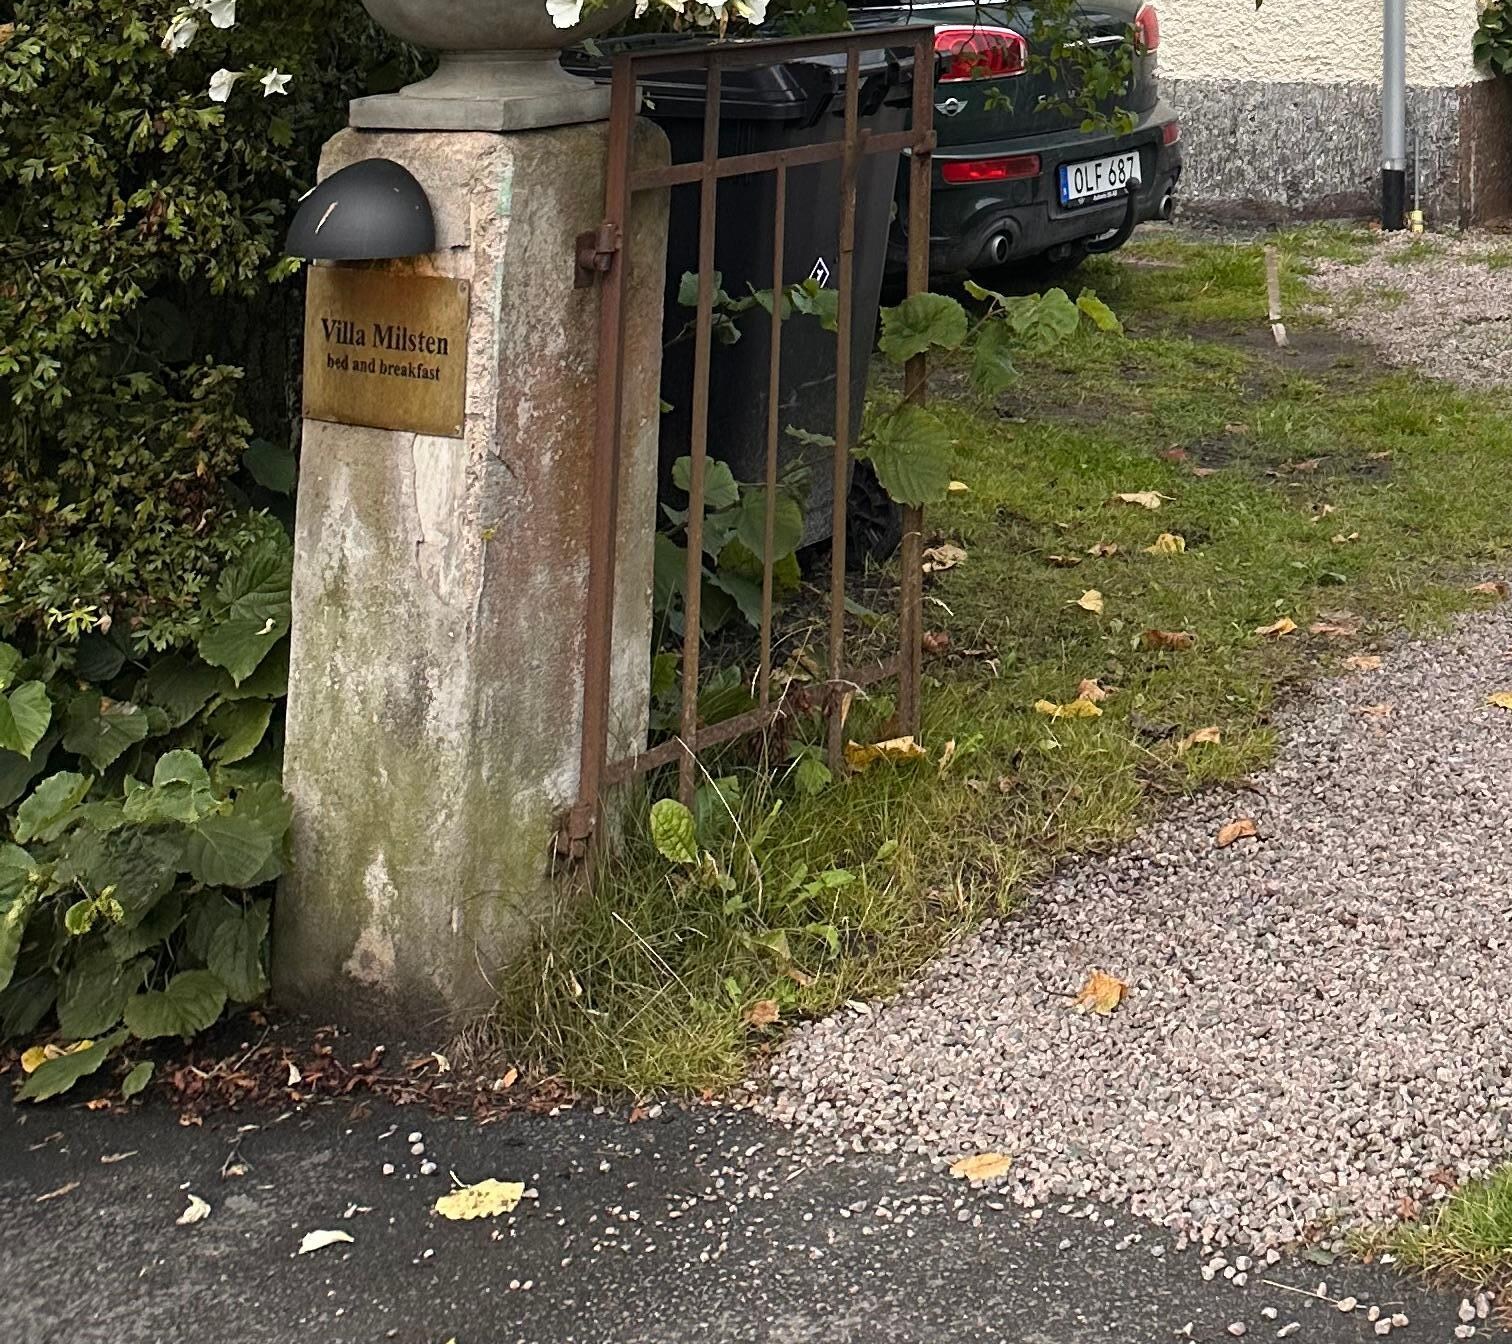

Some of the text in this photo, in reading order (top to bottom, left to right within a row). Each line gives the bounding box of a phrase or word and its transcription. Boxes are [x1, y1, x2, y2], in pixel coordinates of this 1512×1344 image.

[1074, 156, 1133, 193] OLF 687
[321, 318, 448, 355] Villa Milsten
[327, 353, 440, 381] bed and breakfast
